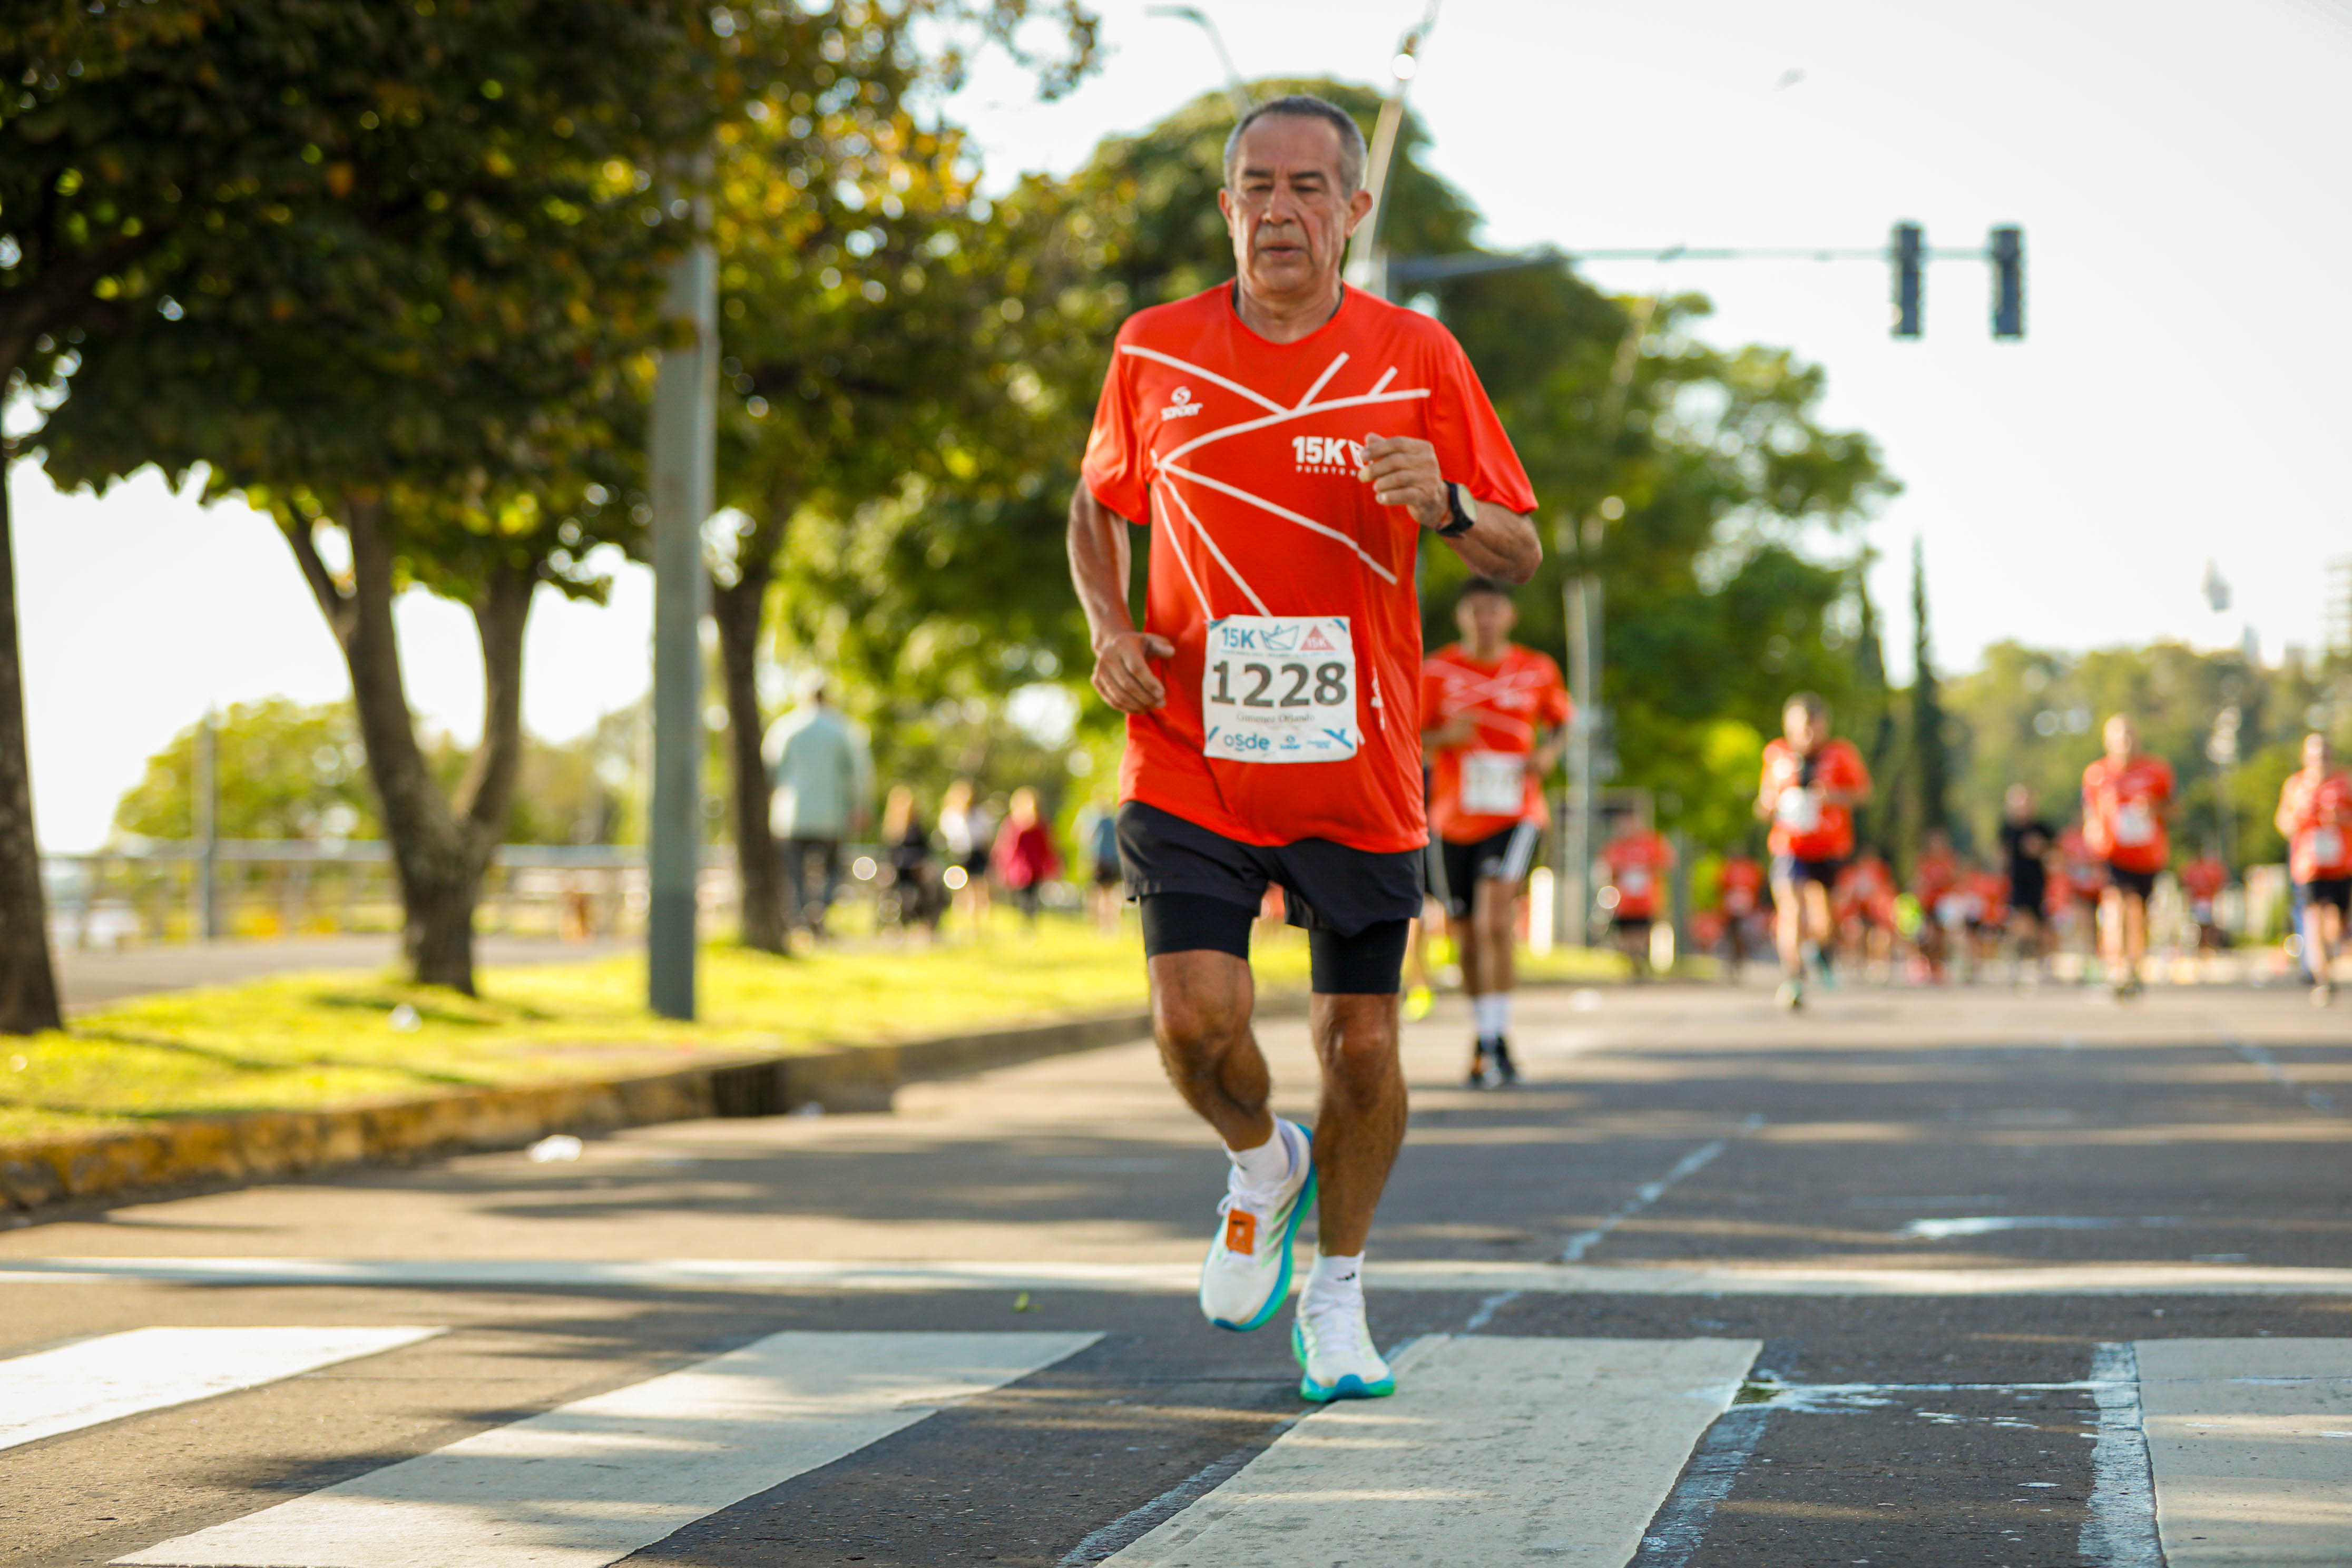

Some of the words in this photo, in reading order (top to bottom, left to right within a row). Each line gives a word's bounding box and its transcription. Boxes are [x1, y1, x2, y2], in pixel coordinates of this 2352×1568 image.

[1292, 436, 1347, 466] 15K
[1296, 464, 1346, 476] PUERTO
[1222, 626, 1256, 649] 15K
[1211, 660, 1347, 707] 1228
[1224, 733, 1270, 751] osde
